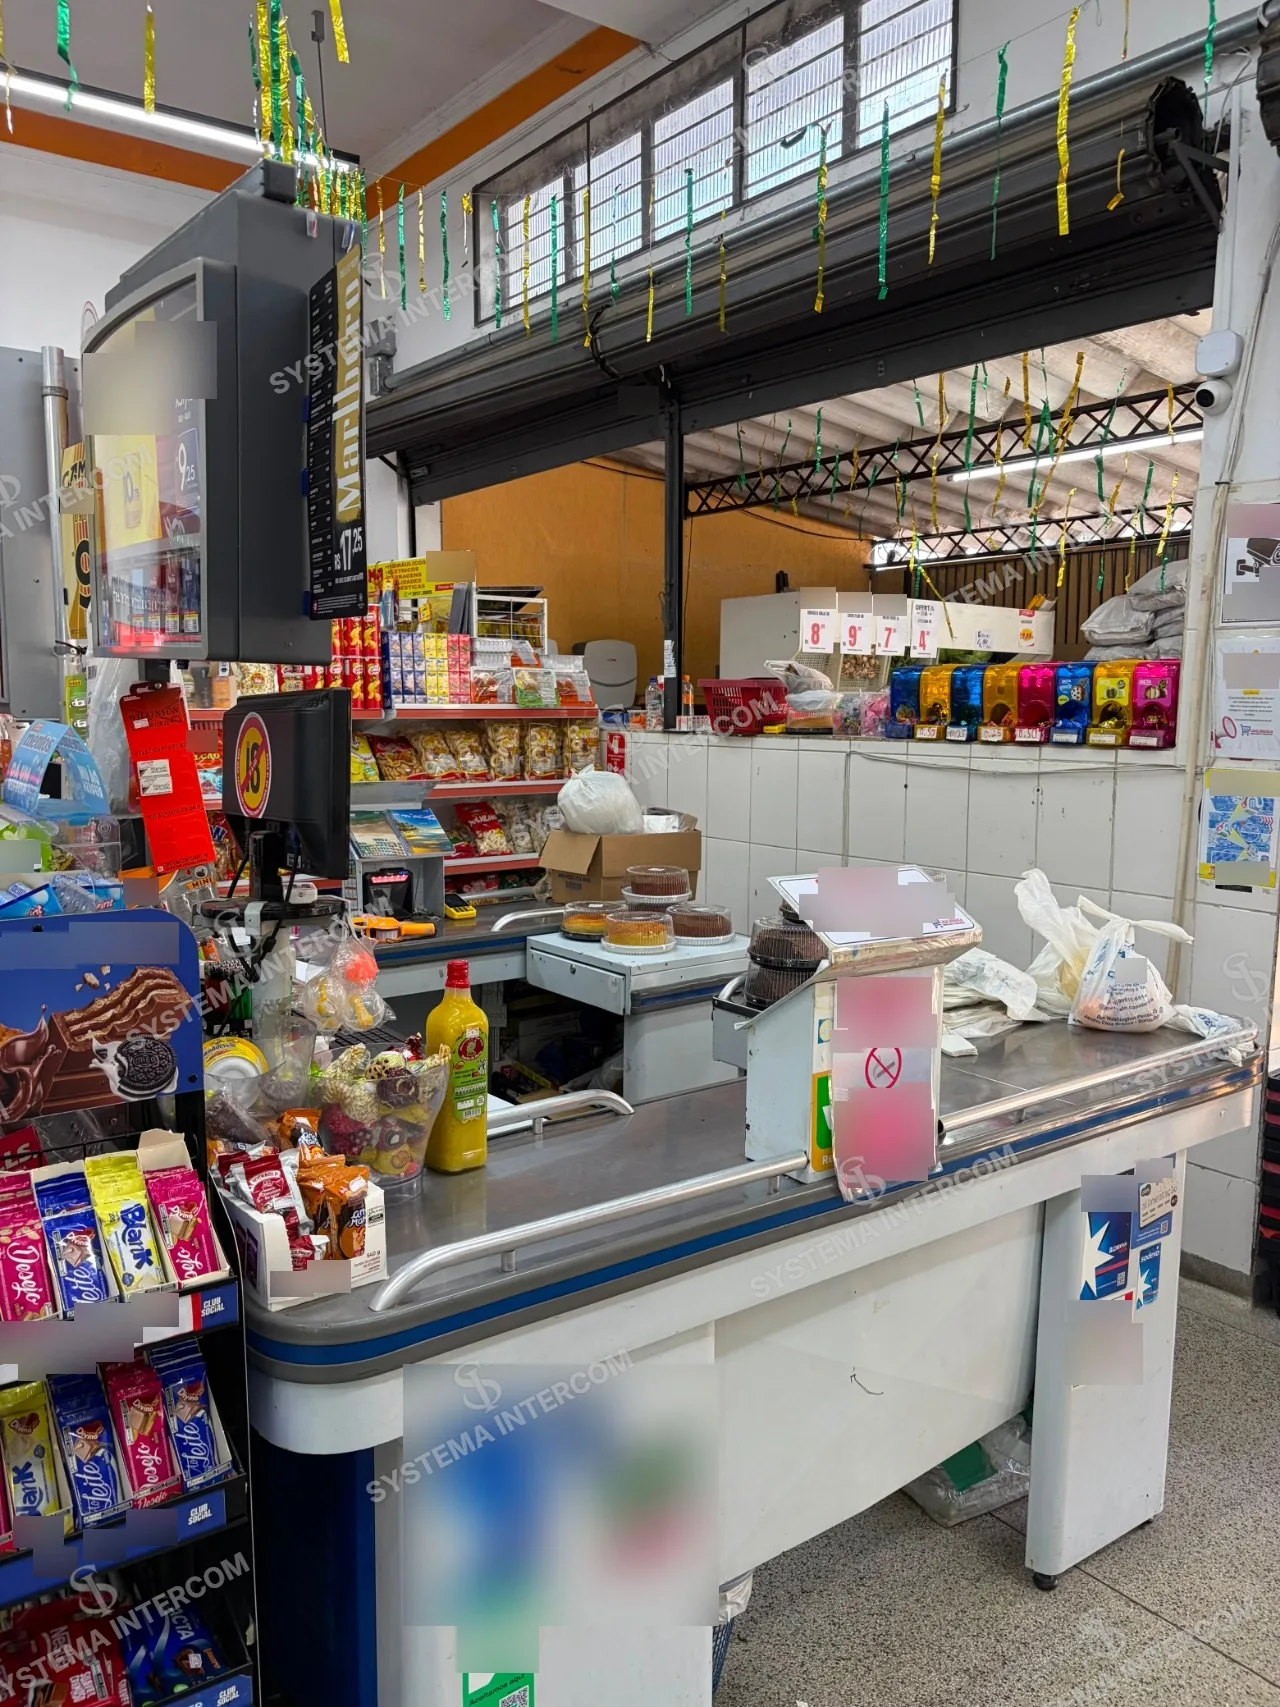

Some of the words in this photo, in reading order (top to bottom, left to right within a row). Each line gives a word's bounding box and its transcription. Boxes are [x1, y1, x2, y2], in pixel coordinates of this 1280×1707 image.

[332, 278, 361, 513] Marlboro
[192, 877, 213, 888] MINI
[201, 1303, 225, 1317] SOCIAL
[203, 1297, 221, 1309] CLUB
[178, 1388, 200, 1402] Divino
[133, 1399, 154, 1412] Divino
[10, 1420, 33, 1434] Divino
[191, 1503, 208, 1516] CLUB
[188, 1510, 212, 1526] SOCIAL
[217, 1691, 239, 1707] SOCIAL
[219, 1685, 236, 1699] CLUB
[469, 1682, 509, 1706] Aceitamos
